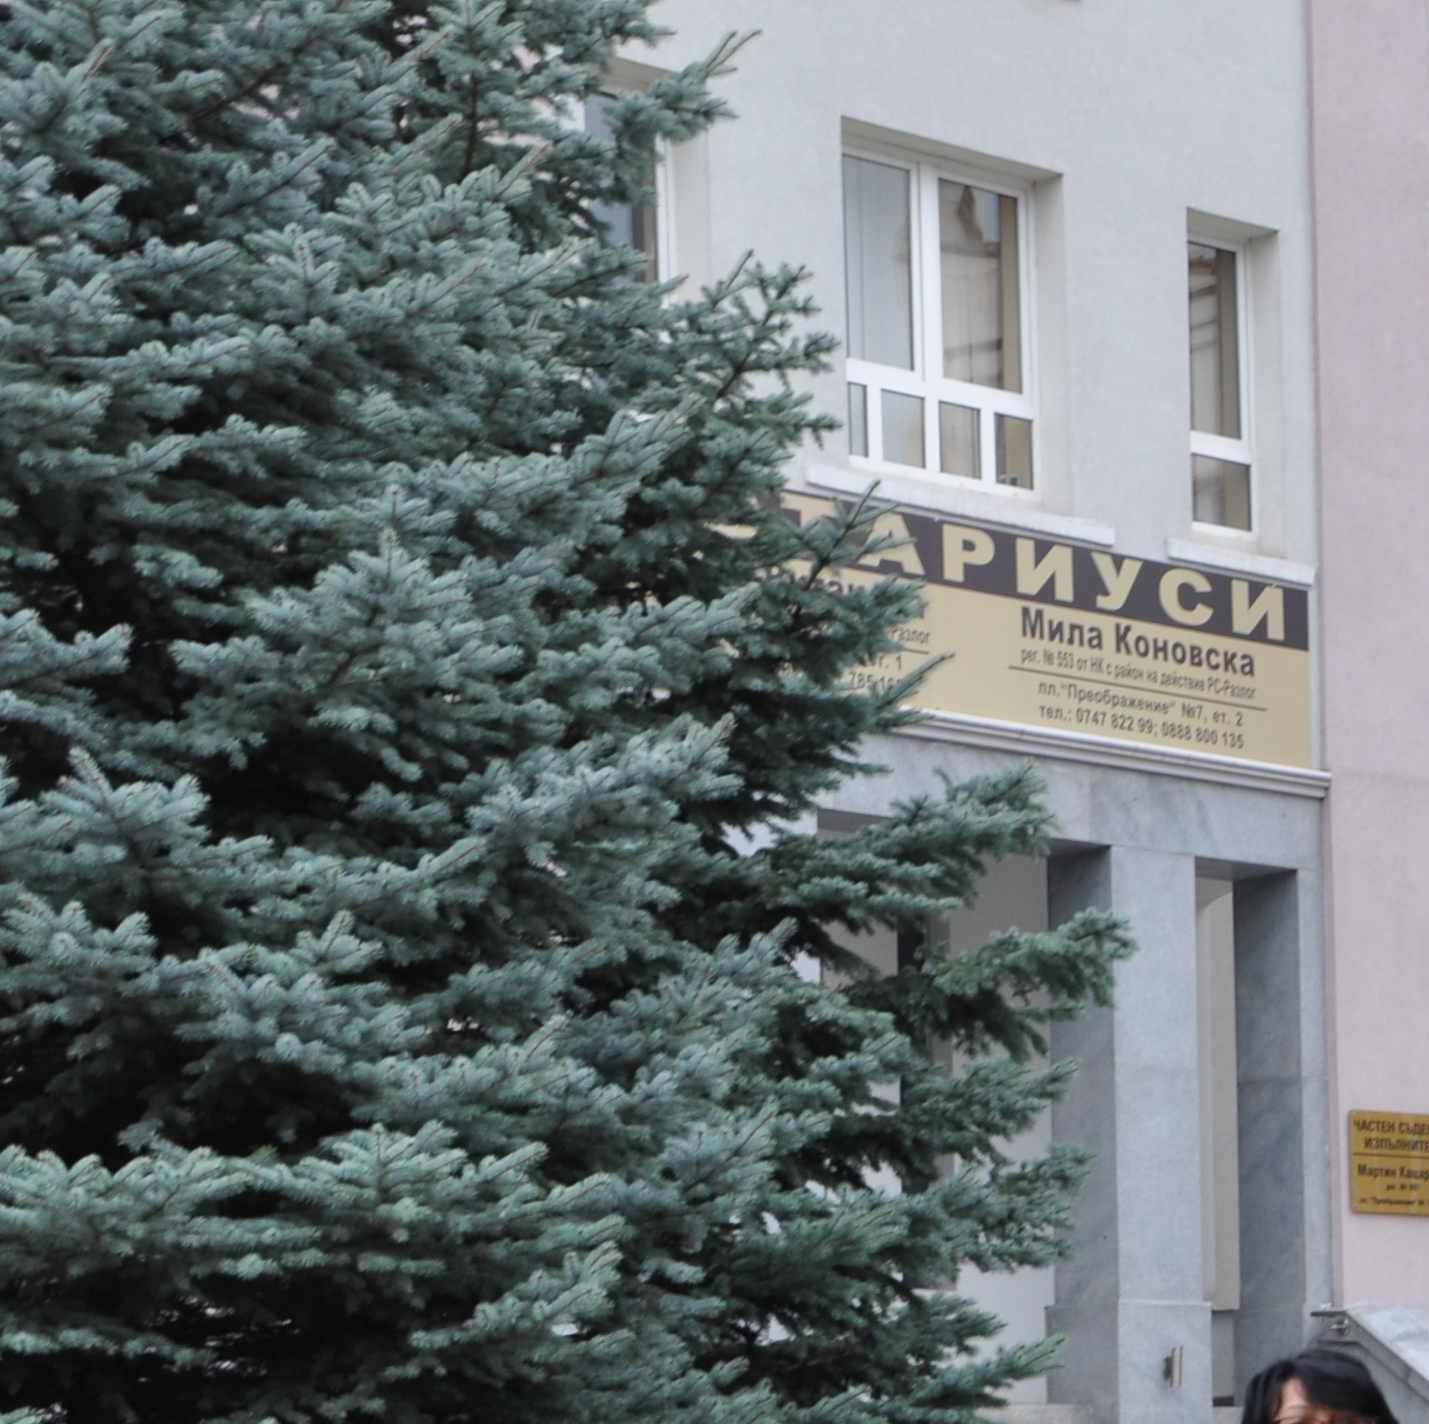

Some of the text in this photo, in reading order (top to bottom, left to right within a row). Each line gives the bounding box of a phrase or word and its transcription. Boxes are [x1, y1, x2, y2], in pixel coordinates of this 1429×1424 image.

[1021, 606, 1255, 677] Мила Коновска
[1236, 712, 1244, 726] 2
[1222, 731, 1244, 749] 135
[1353, 1119, 1395, 1133] ЧАСТЕН
